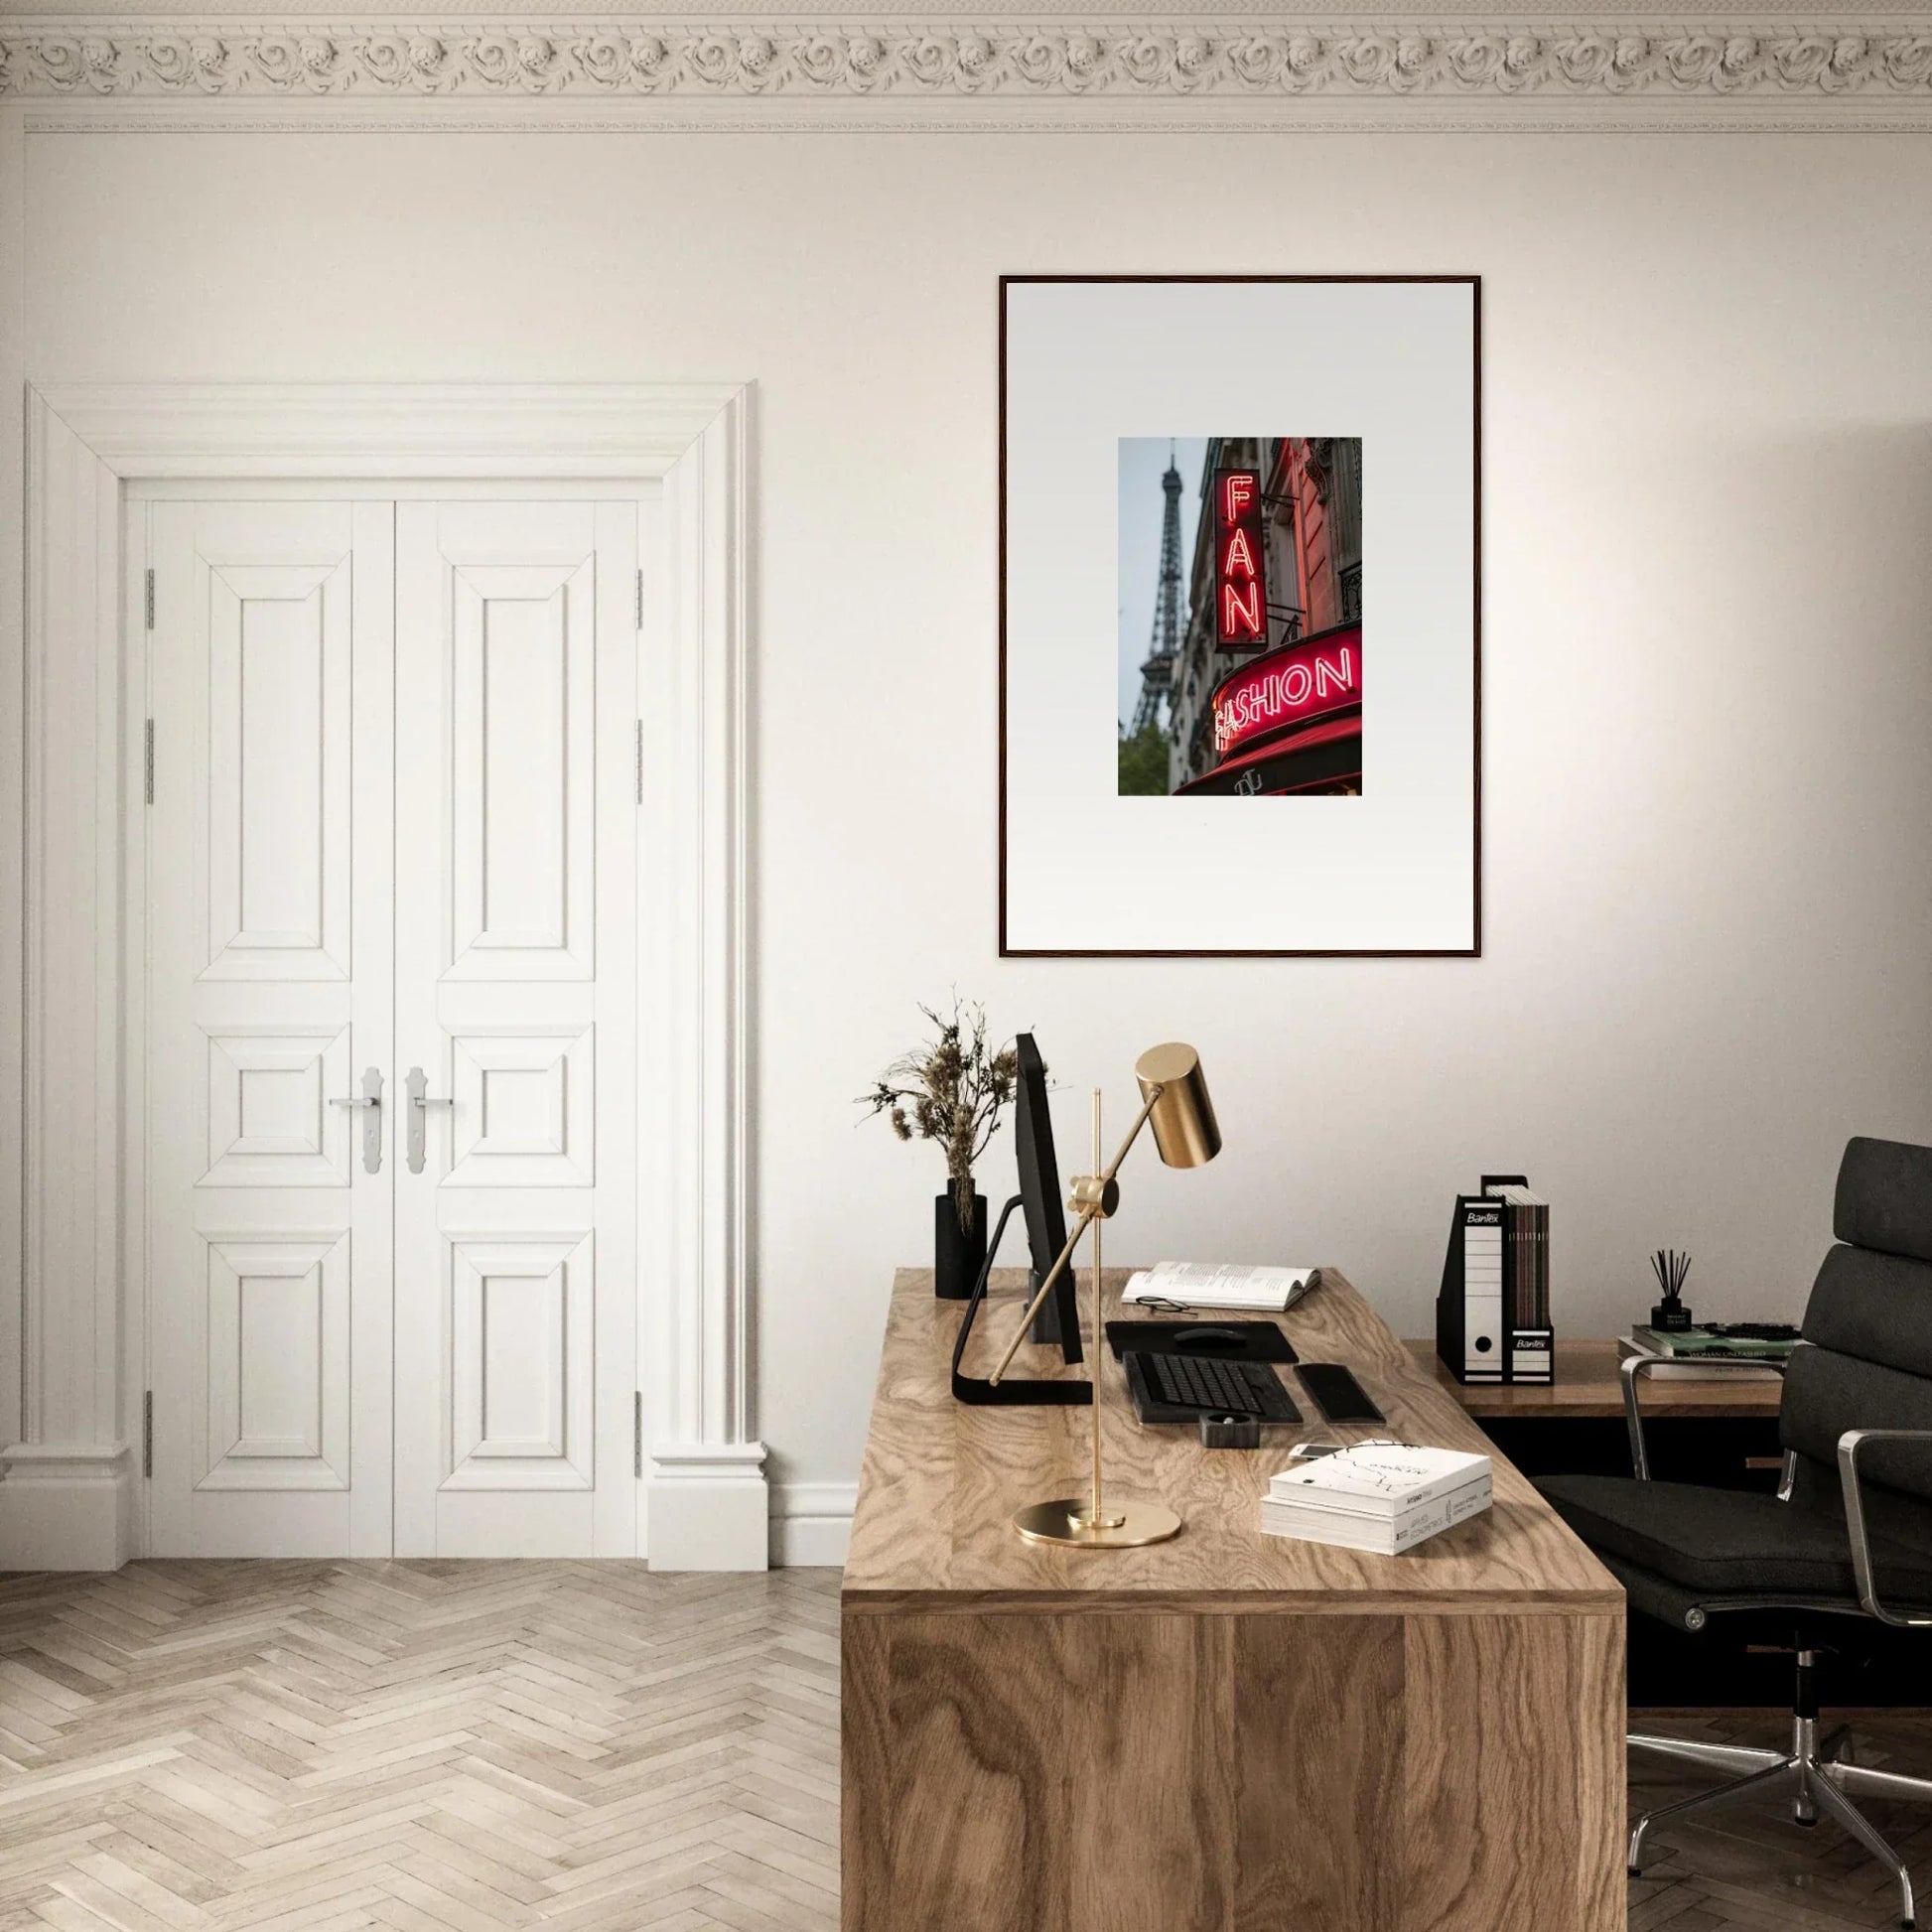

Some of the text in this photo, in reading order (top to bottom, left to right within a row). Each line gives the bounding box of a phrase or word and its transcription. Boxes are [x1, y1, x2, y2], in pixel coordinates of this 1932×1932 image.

[1226, 476, 1260, 635] FAN
[1215, 647, 1353, 752] FASHION
[1467, 1212, 1499, 1223] Bantex
